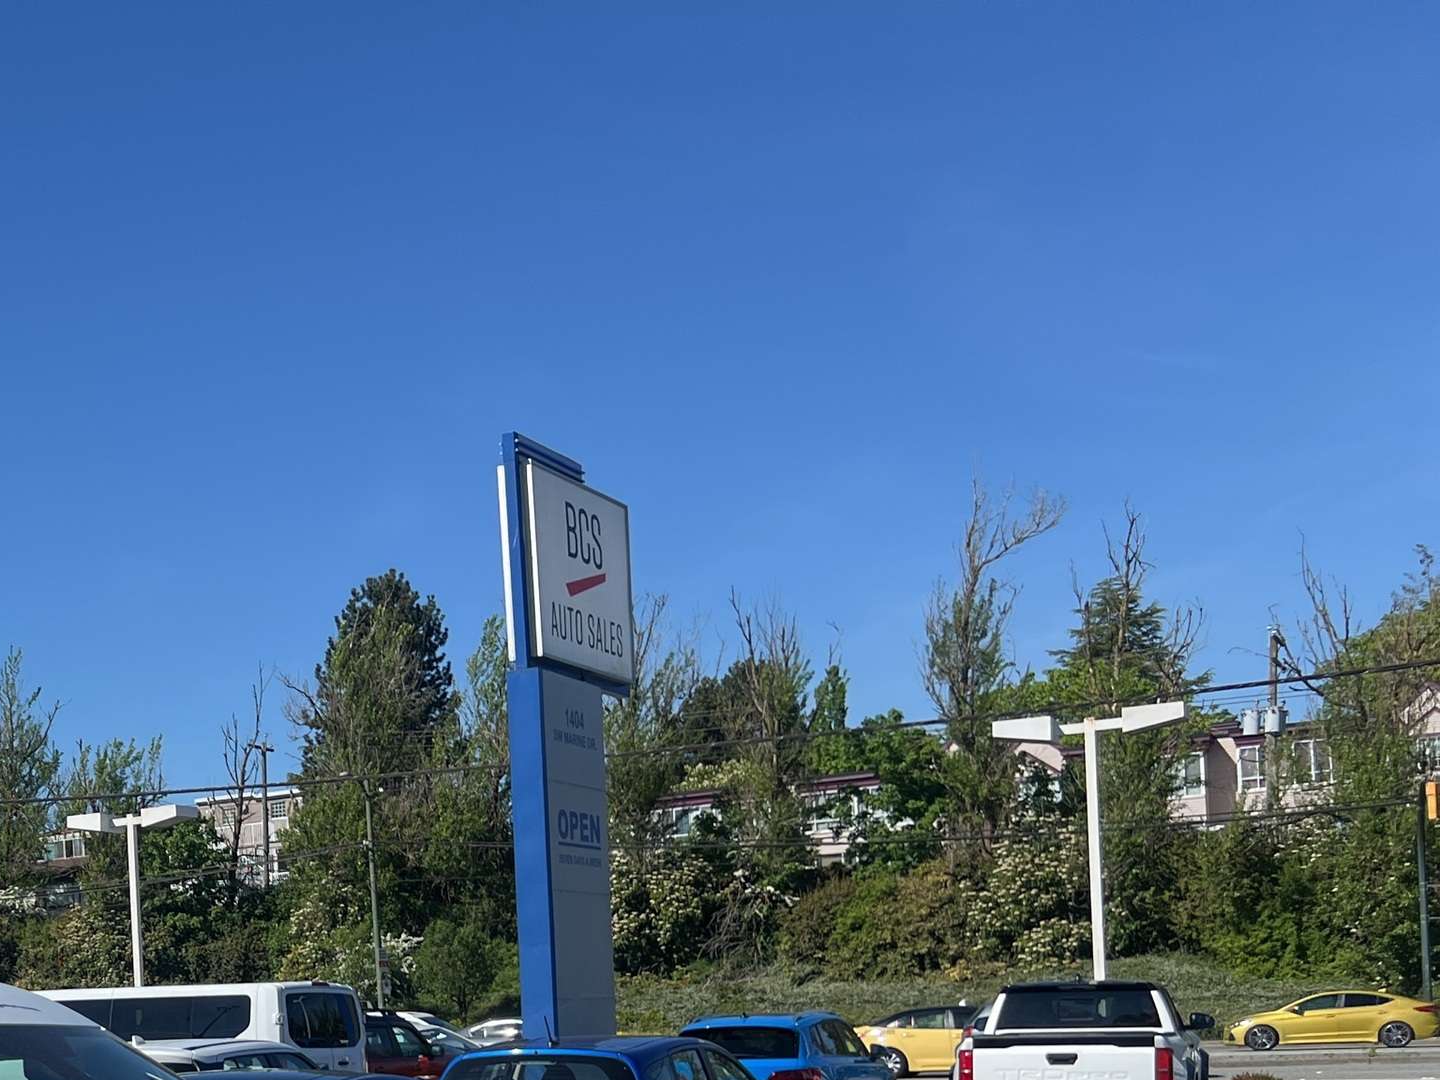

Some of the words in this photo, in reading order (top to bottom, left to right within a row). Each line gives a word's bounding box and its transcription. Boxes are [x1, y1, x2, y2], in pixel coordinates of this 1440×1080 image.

[565, 500, 603, 570] BCS
[551, 601, 583, 646] AUTO
[587, 613, 624, 658] SALES
[565, 708, 585, 730] 1404
[558, 808, 601, 845] OPEN
